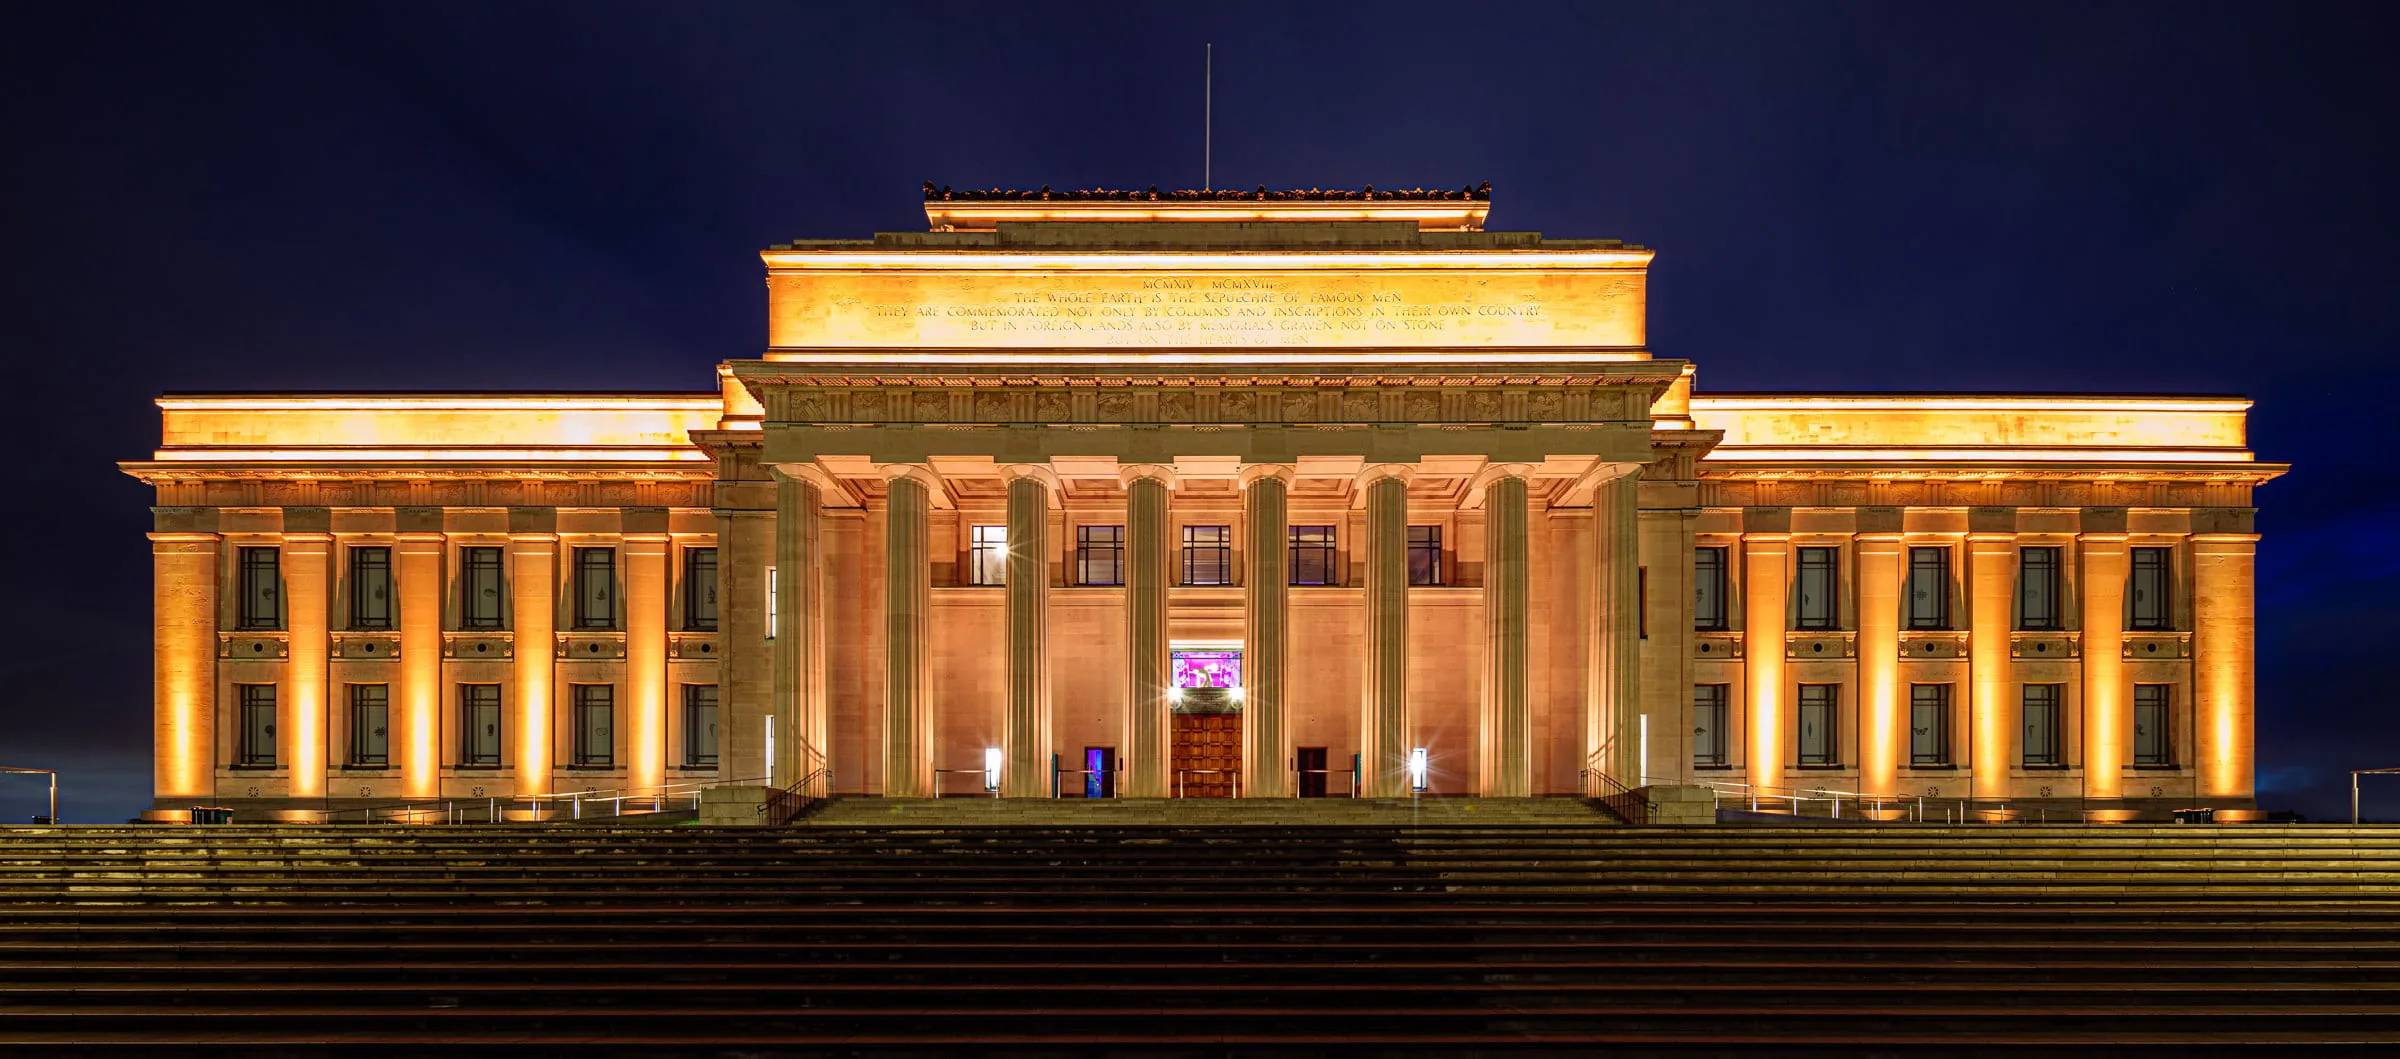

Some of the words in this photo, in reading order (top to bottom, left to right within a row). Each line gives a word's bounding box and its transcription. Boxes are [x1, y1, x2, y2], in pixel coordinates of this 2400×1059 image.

[1143, 278, 1195, 289] MCMXIV
[1212, 278, 1273, 289] MCMXVIII
[1014, 292, 1040, 303] THE
[1047, 292, 1092, 303] WHOLE
[1101, 292, 1142, 303] EARTH
[1152, 292, 1162, 303] IS
[1171, 292, 1196, 303] THE
[1204, 292, 1275, 303] SEPULCHRE
[1283, 292, 1300, 303] OF
[1311, 292, 1363, 303] FAMOUS
[1372, 292, 1401, 303] MEN
[875, 306, 908, 317] THEY
[916, 306, 940, 317] ARE
[947, 306, 1059, 317] COMMEMORATED
[1067, 306, 1093, 317] NOT
[1101, 306, 1136, 317] ONLY
[1145, 306, 1159, 317] BY
[1166, 306, 1230, 317] COLUMNS
[1237, 306, 1266, 317] AND
[1273, 306, 1363, 317] INSCRIPTIONS
[1371, 306, 1385, 317] IN
[1393, 306, 1431, 317] THEIR
[1438, 306, 1471, 317] OWN
[1478, 306, 1541, 317] COUNTRY
